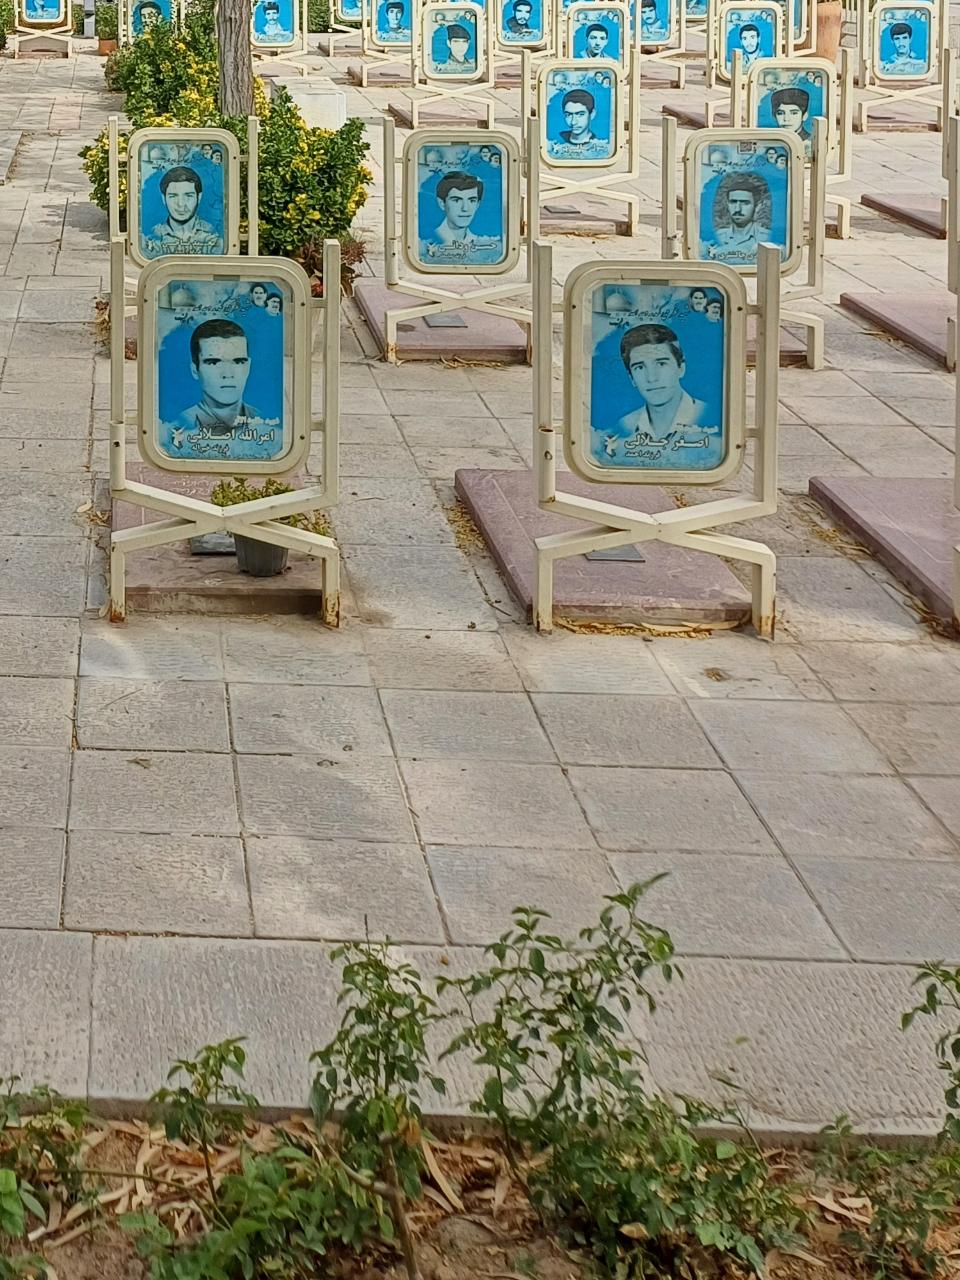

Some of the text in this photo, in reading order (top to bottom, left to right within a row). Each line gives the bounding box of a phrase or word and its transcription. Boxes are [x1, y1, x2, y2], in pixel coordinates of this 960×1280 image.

[186, 426, 236, 444] اصلانی
[623, 431, 710, 451] اصغر جلالی
[211, 443, 230, 455] فرزند
[624, 449, 662, 460] فرزند احمد
